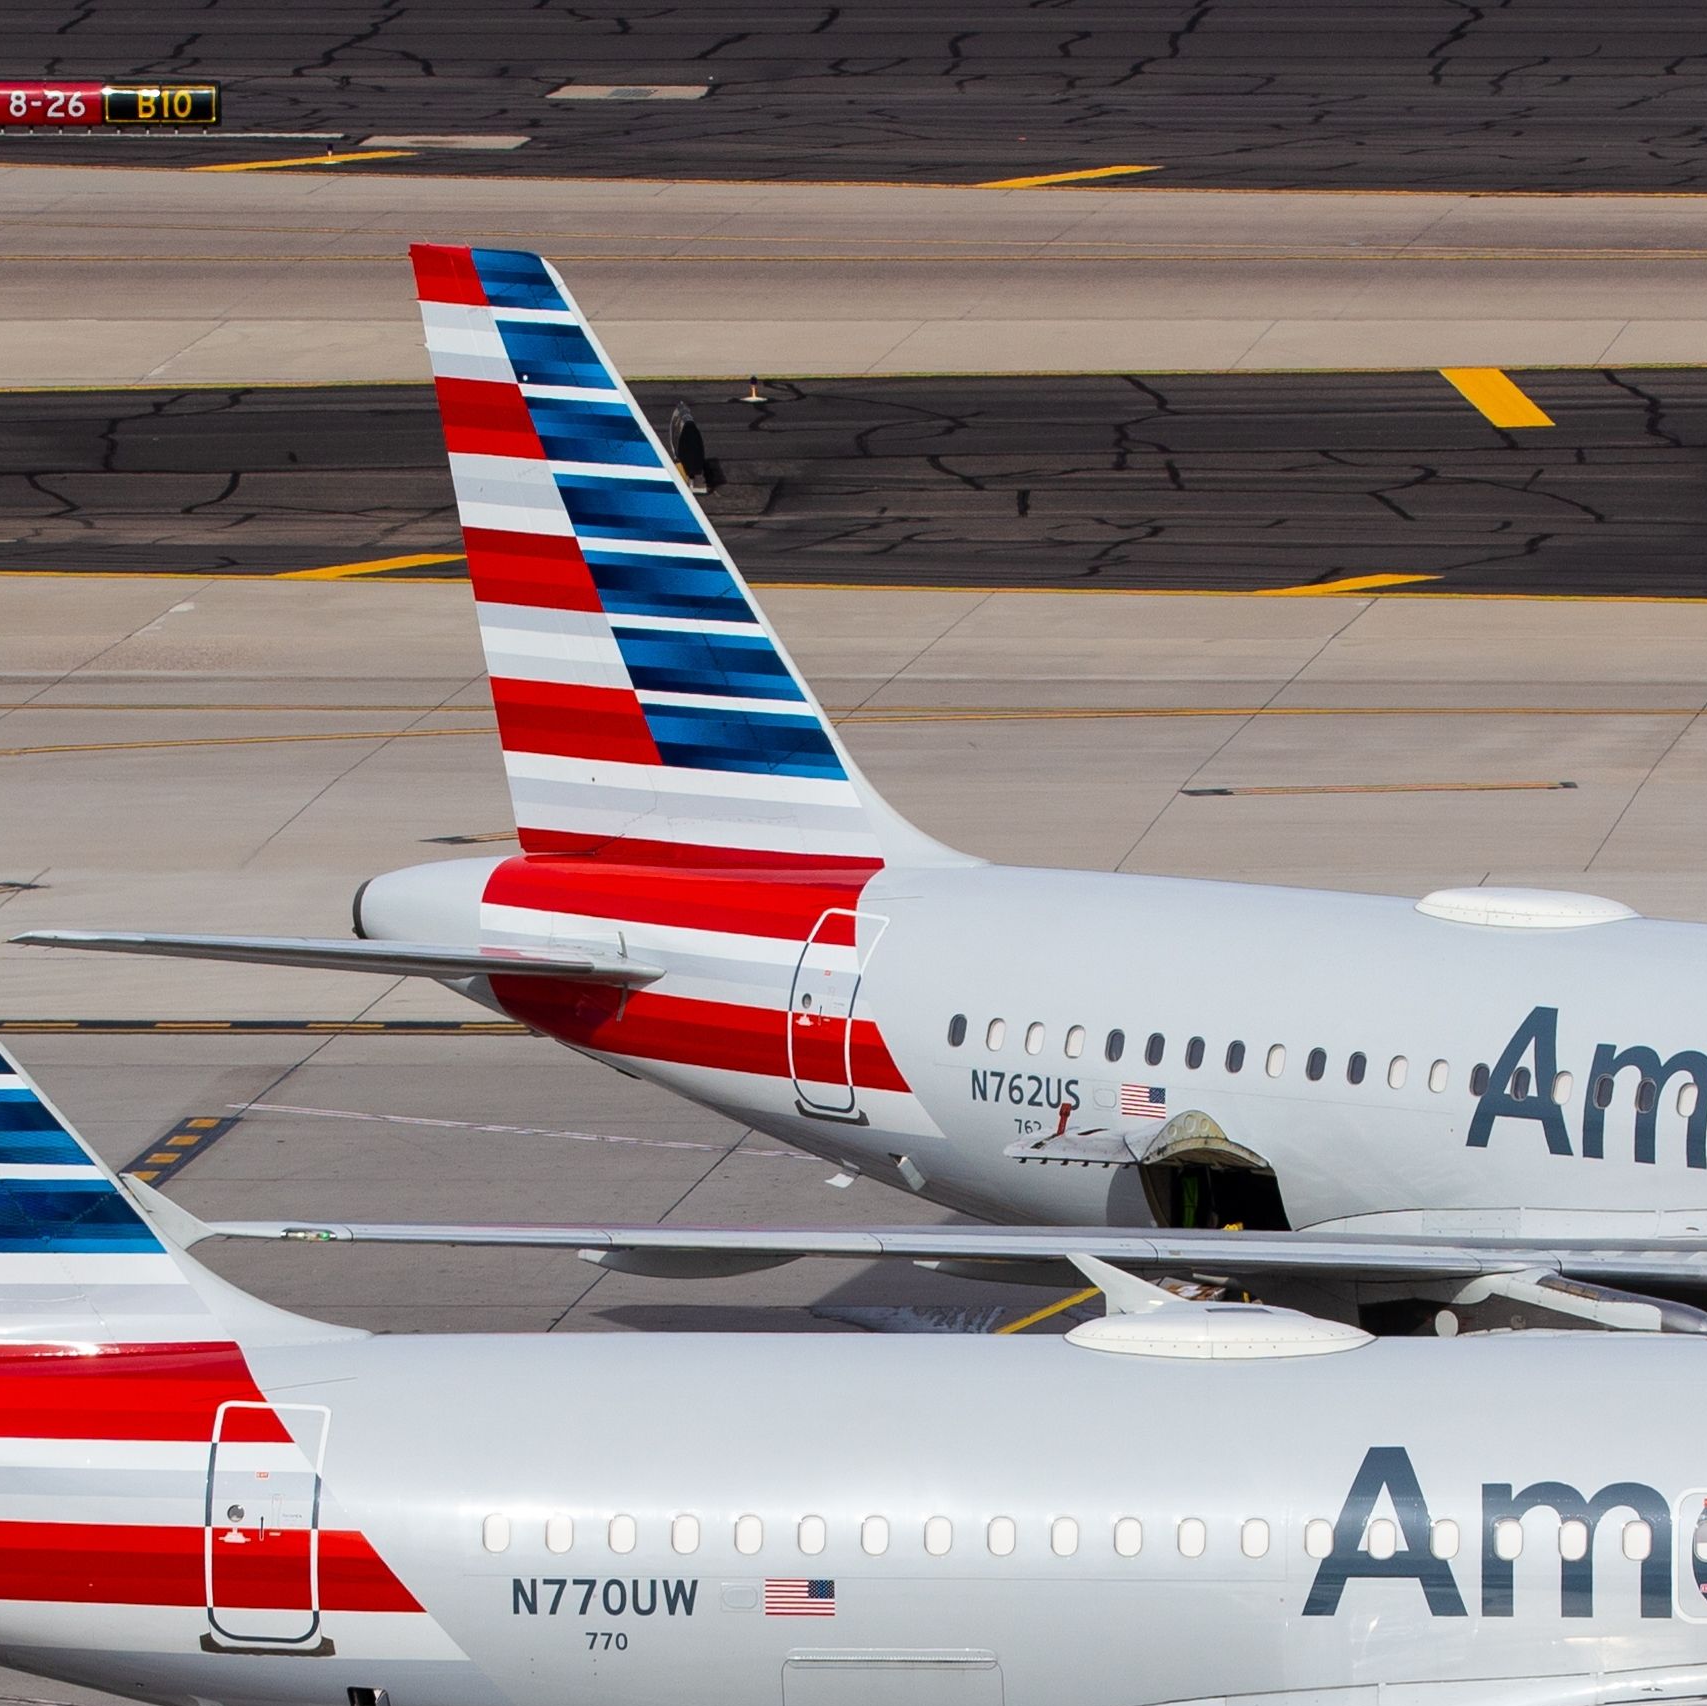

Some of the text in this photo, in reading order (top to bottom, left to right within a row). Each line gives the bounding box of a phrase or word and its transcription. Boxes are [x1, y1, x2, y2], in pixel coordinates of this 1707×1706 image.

[9, 90, 86, 118] 8-26
[137, 90, 193, 118] B10
[971, 1069, 1081, 1112] N762US
[512, 1578, 698, 1616] N770UW
[585, 1632, 628, 1651] 770
